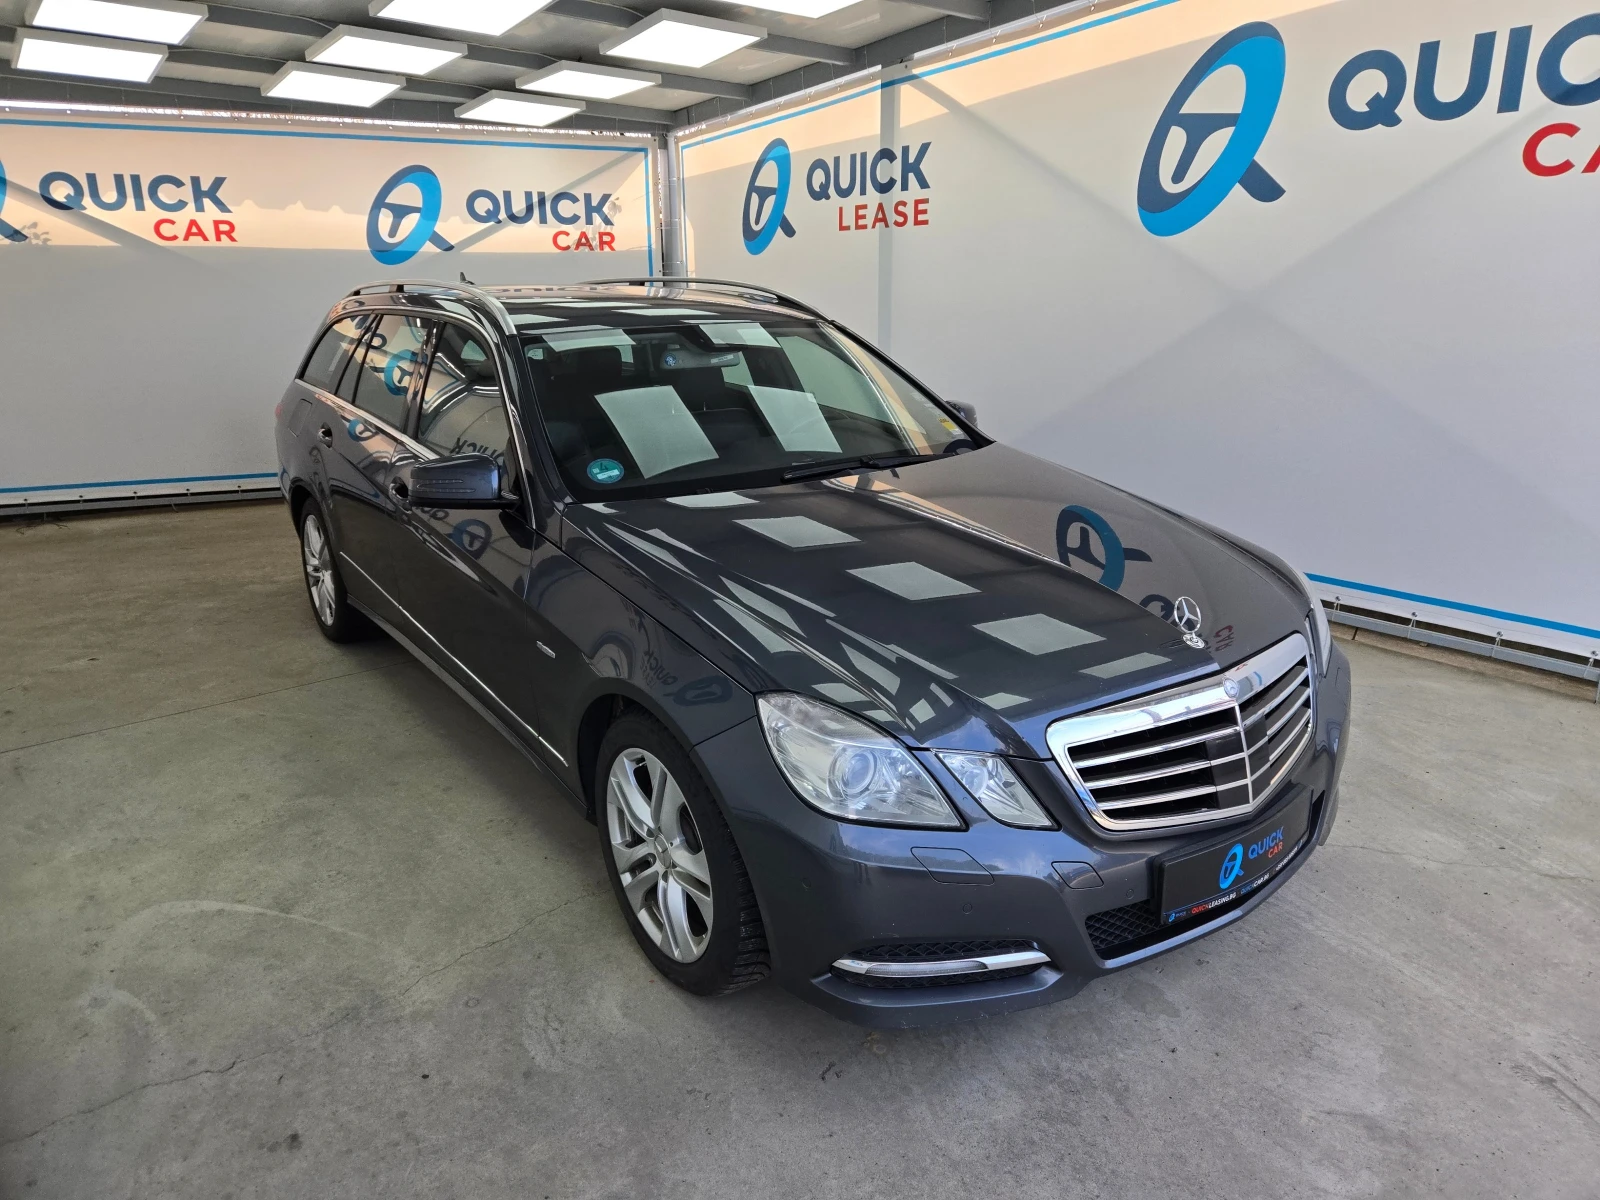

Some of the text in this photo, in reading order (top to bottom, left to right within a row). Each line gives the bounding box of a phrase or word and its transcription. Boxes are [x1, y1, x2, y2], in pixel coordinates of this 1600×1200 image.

[1522, 122, 1600, 177] C
[807, 143, 931, 199] QUICK
[39, 171, 233, 212] QUICK
[466, 189, 615, 226] QUICK
[152, 218, 237, 243] CAR
[838, 198, 930, 231] LEASE
[552, 230, 616, 252] CAR
[1248, 826, 1284, 860] QUICK
[1267, 841, 1283, 858] CAR
